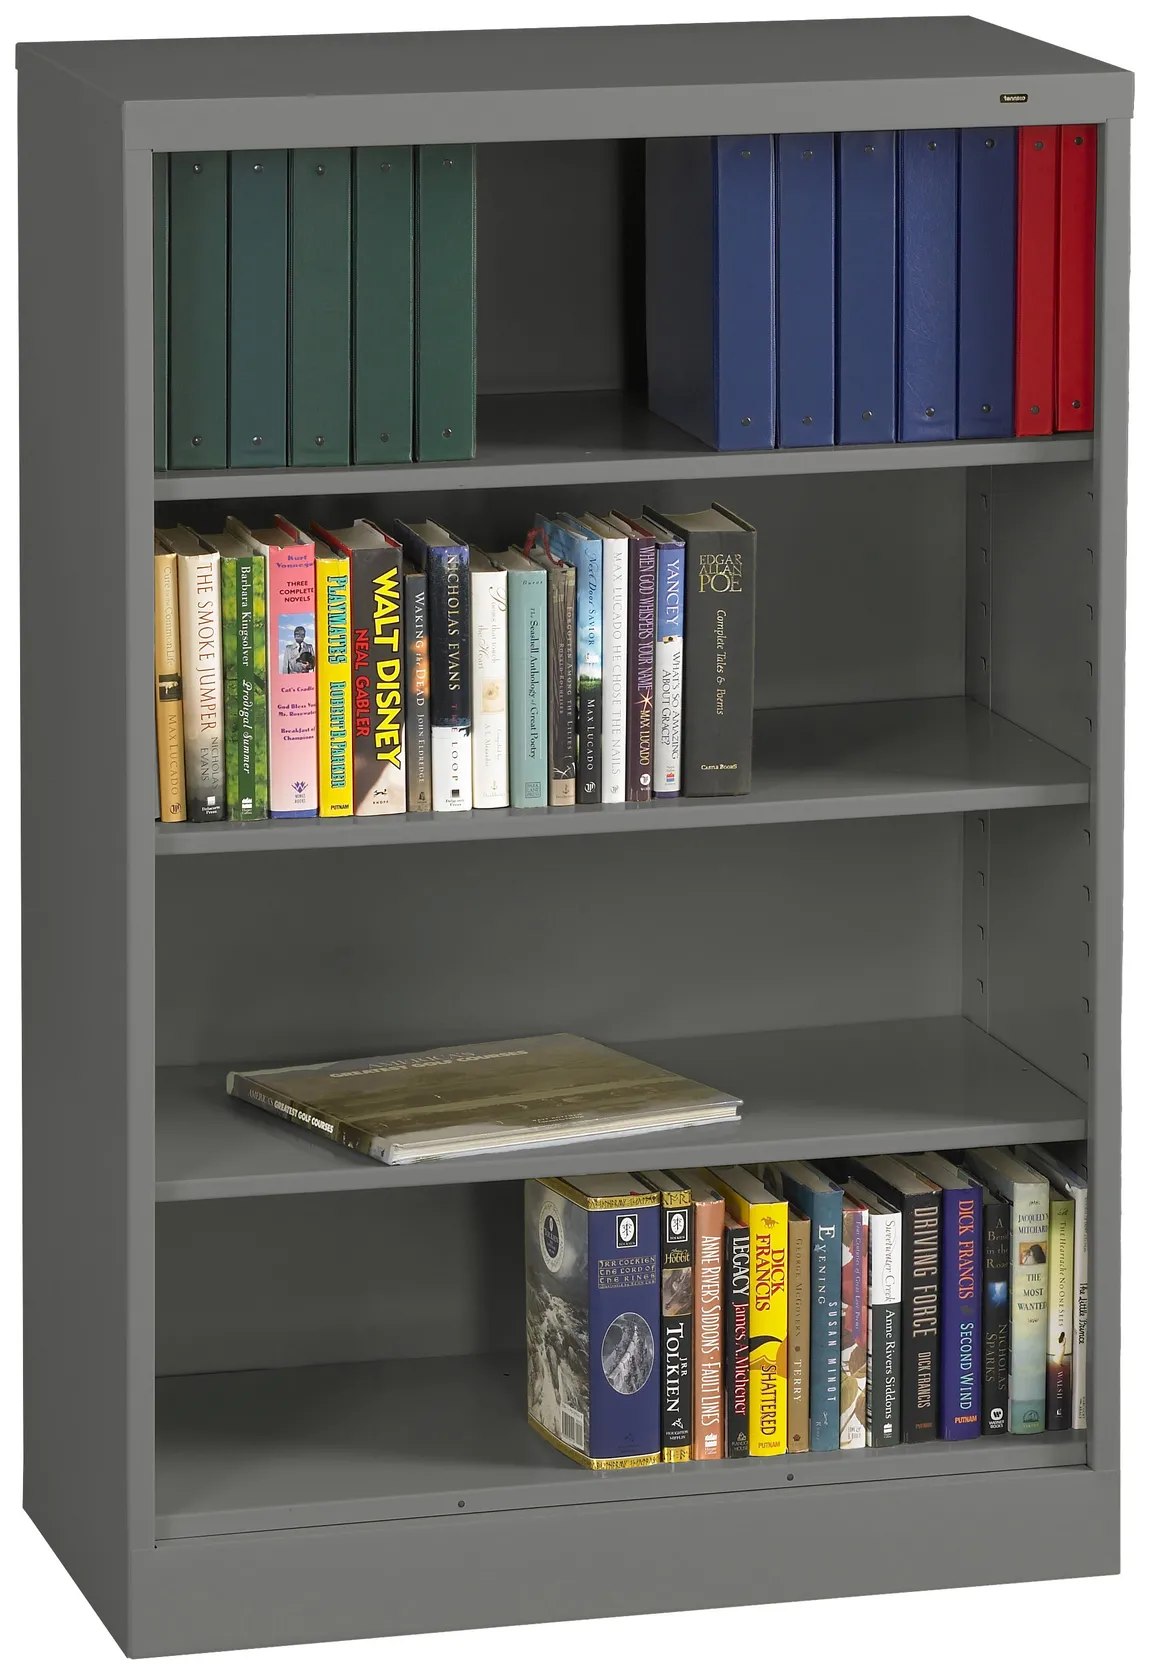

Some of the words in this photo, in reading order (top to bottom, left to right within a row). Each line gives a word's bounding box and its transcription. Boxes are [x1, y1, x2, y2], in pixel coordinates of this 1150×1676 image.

[164, 566, 172, 588] Cure
[585, 548, 598, 580] Next
[612, 552, 622, 582] MAX
[640, 546, 656, 574] WHEN
[700, 554, 742, 565] EDGAR
[700, 564, 742, 576] ALLAN
[196, 562, 214, 594] THE
[241, 566, 251, 607] Barbara
[447, 554, 459, 636] NICHOLAS
[588, 582, 597, 607] Door
[639, 575, 655, 595] GOD
[666, 560, 680, 626] YANCEY
[698, 573, 742, 592] POE
[327, 575, 348, 666] PLAYMATES
[372, 567, 400, 652] WALT
[415, 592, 424, 648] WAKING
[488, 586, 507, 622] Poems
[612, 588, 622, 640] LUCADO
[638, 596, 654, 640] WHISPERS
[164, 607, 174, 648] Common
[198, 601, 215, 661] SMOKE
[239, 612, 252, 666] Kingsolver
[530, 620, 540, 654] Seashell
[714, 610, 726, 650] Complete
[166, 650, 176, 666] Life
[355, 629, 370, 670] NEAL
[448, 644, 460, 691] EVANS
[612, 646, 622, 661] HE
[638, 641, 654, 664] YOUR
[716, 652, 726, 674] Tales
[416, 669, 426, 706] DEAD
[528, 656, 540, 699] Anthology
[612, 664, 622, 706] CHOSE
[638, 666, 653, 691] NAME
[662, 670, 671, 704] ABOUT
[672, 652, 680, 690] WHAT'S
[196, 668, 216, 732] JUMPER
[239, 680, 253, 729] Prodigal
[330, 681, 347, 728] ROBERT
[355, 676, 370, 736] GABLER
[375, 659, 401, 770] DISNEY
[530, 706, 538, 730] Great
[587, 700, 596, 722] MAX
[672, 693, 680, 708] SO
[716, 689, 726, 715] Poems
[168, 714, 176, 741] MAX
[330, 730, 347, 740] B.
[566, 720, 574, 750] LILIES
[612, 711, 621, 734] THE
[640, 710, 650, 728] MAX
[661, 708, 672, 746] GRACE?
[672, 711, 680, 760] AMAZING
[211, 736, 220, 790] NICHOLAS
[242, 732, 253, 774] Summer
[528, 732, 538, 759] Poetry
[586, 726, 595, 770] LUCADO
[612, 740, 621, 775] NAILS
[640, 730, 650, 766] LUCADO
[169, 744, 178, 796] LUCADO
[200, 748, 209, 781] EVANS
[330, 741, 348, 788] PARKER
[330, 1064, 409, 1078] GREATEST
[411, 1058, 453, 1068] GOLF
[456, 1050, 528, 1062] COURSES
[274, 1100, 298, 1119] GREATEST
[298, 1111, 312, 1123] GOLF
[312, 1117, 334, 1134] COURSES
[958, 1200, 974, 1236] DICK
[996, 1218, 1004, 1228] A
[664, 1251, 690, 1264] Hobbit
[702, 1236, 721, 1264] ANNE
[884, 1220, 896, 1272] Sweetwater
[914, 1206, 938, 1277] DRIVING
[986, 1246, 994, 1254] in
[600, 1260, 616, 1268] JRR
[618, 1256, 654, 1266] TOLKIEN
[600, 1268, 617, 1276] THE
[620, 1266, 642, 1274] LORD
[624, 1273, 655, 1282] RINGS
[732, 1236, 750, 1296] LEGACY
[755, 1234, 770, 1312] FRANCIS
[771, 1248, 785, 1296] DICK
[818, 1224, 836, 1305] EVENING
[958, 1241, 974, 1299] FRANCIS
[702, 1266, 721, 1304] RIVERS
[884, 1275, 896, 1302] Creek
[1024, 1288, 1043, 1296] MOST
[1080, 1282, 1088, 1294] The
[732, 1302, 748, 1341] James
[828, 1302, 838, 1346] SUSAN
[886, 1310, 896, 1338] Anne
[913, 1284, 938, 1338] FORCE
[1079, 1296, 1088, 1316] Little
[702, 1305, 721, 1354] SIDDONS
[960, 1322, 974, 1370] SECOND
[1078, 1319, 1088, 1344] Prince
[666, 1322, 684, 1412] TOLKIEN
[680, 1358, 688, 1376] JRR
[736, 1343, 749, 1357] A.
[886, 1341, 896, 1374] Rivers
[918, 1352, 932, 1372] DICK
[986, 1332, 998, 1382] SPARKS
[998, 1324, 1008, 1390] NICHOLAS
[702, 1362, 721, 1392] FAULT
[735, 1357, 750, 1416] Michener
[793, 1359, 802, 1402] TERRY
[828, 1358, 836, 1402] MINOT
[917, 1373, 932, 1408] FRANCIS
[960, 1372, 974, 1410] WIND
[702, 1396, 721, 1426] LINES
[760, 1364, 777, 1436] SHATTERED
[886, 1376, 896, 1419] Siddons
[954, 1416, 978, 1424] PUTNAM
